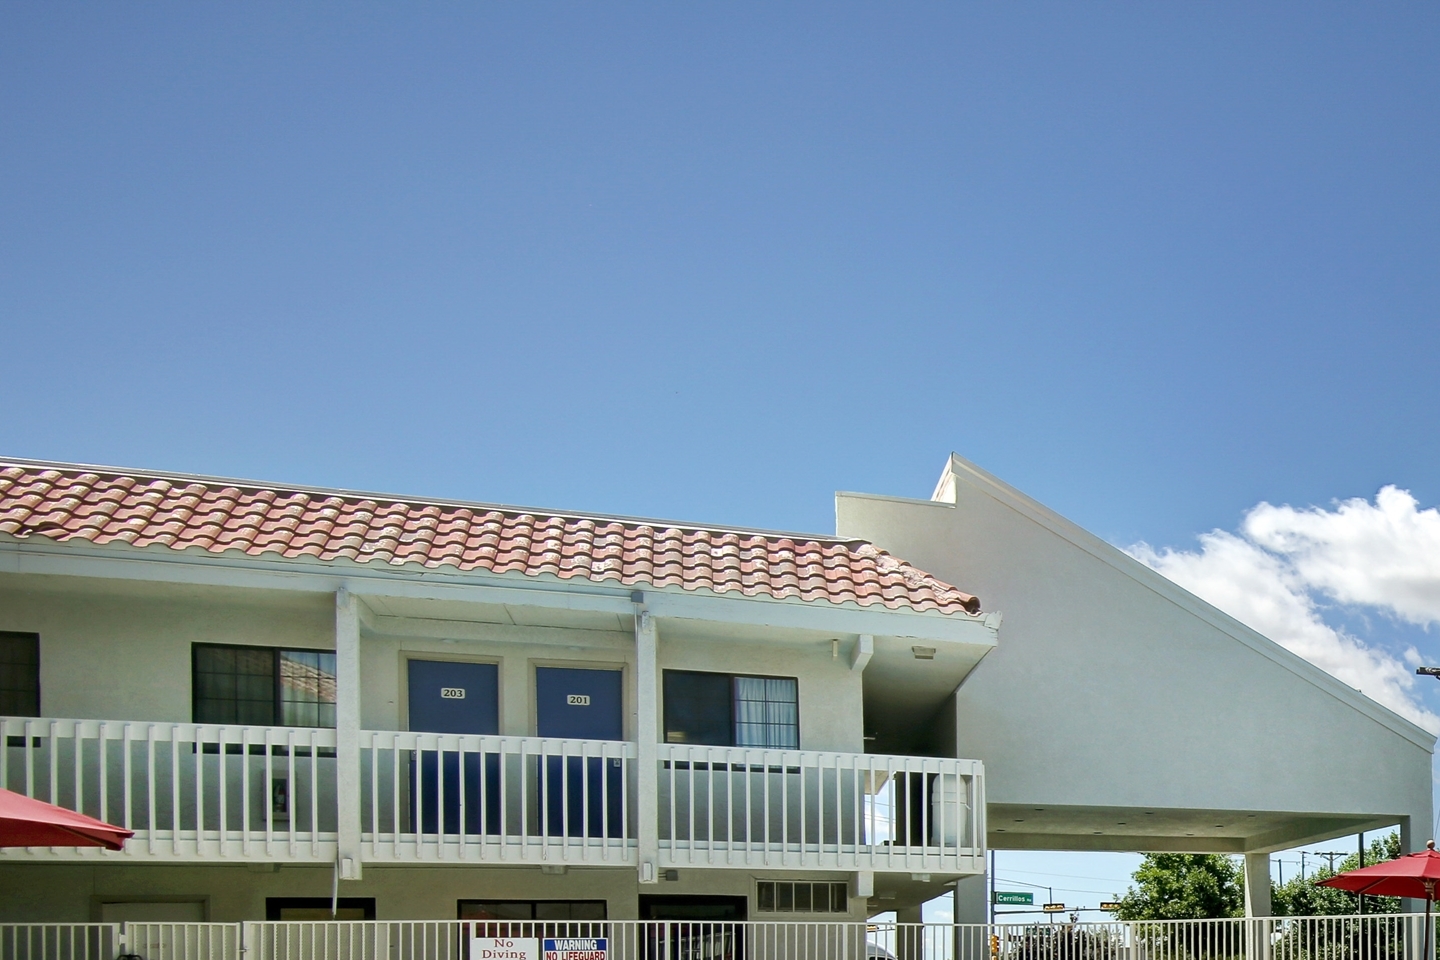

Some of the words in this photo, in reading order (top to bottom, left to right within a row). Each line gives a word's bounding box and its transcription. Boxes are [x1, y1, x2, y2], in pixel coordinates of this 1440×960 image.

[443, 689, 463, 698] 203
[570, 696, 588, 704] 201
[998, 895, 1025, 903] Cerrillos
[494, 939, 514, 948] No
[554, 940, 598, 950] WARNING
[482, 949, 527, 960] Diving
[546, 951, 558, 960] NO
[562, 951, 606, 960] LIFEGUARD
